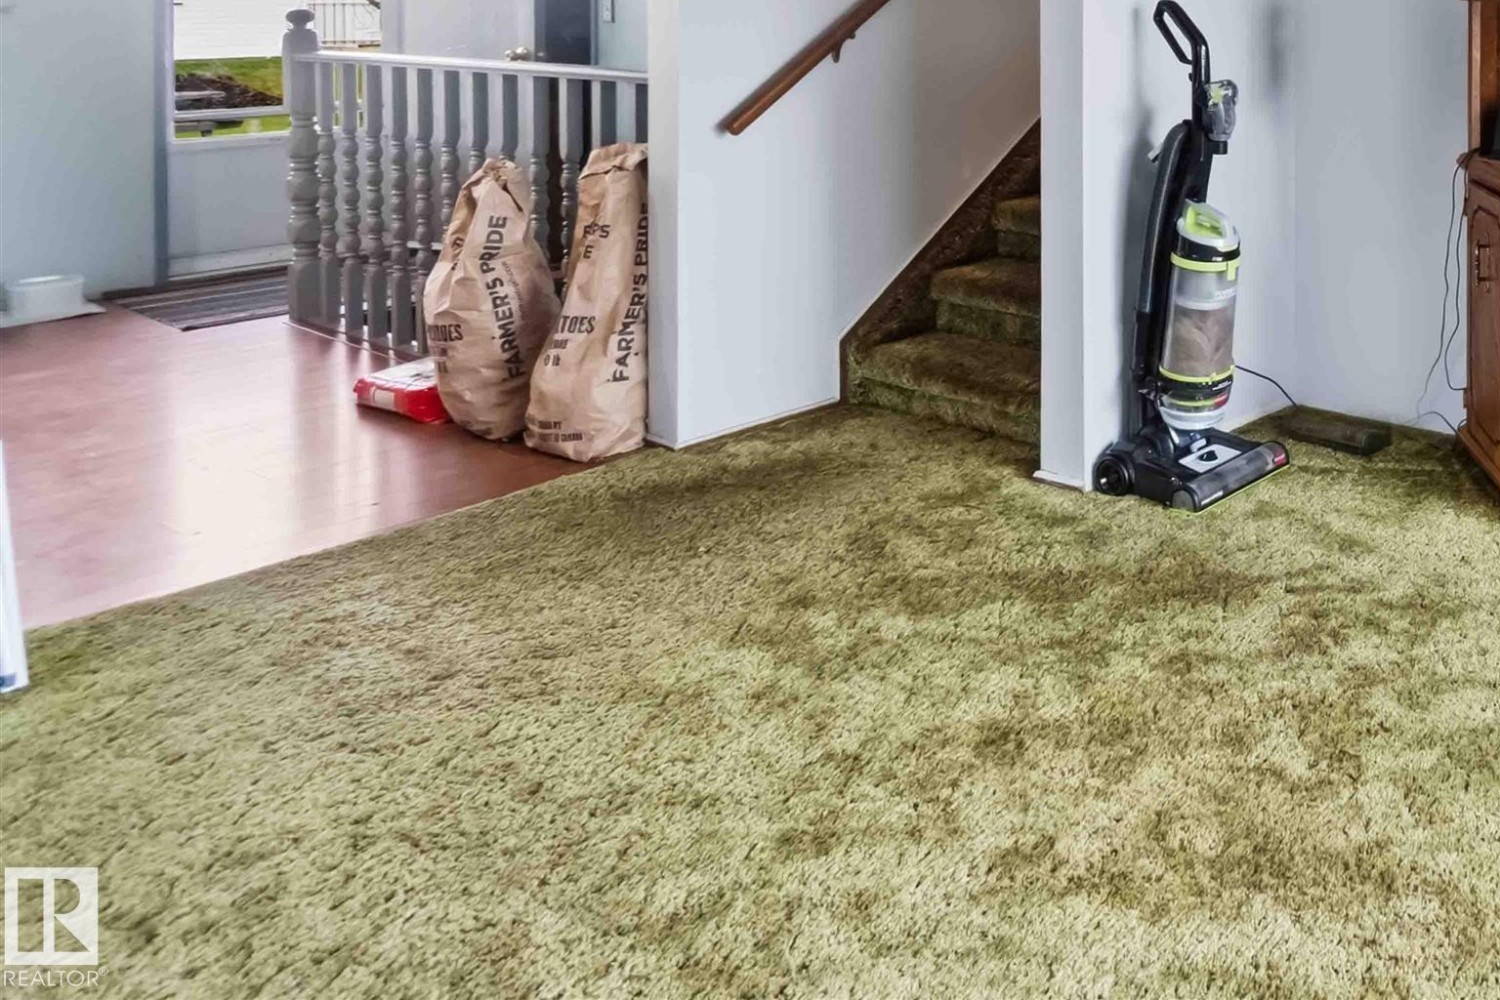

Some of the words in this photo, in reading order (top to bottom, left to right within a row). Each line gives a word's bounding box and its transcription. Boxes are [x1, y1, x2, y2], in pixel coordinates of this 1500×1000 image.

[479, 215, 508, 274] PRIDE
[486, 277, 527, 379] FARMER'S
[612, 273, 648, 382] FARMER'S
